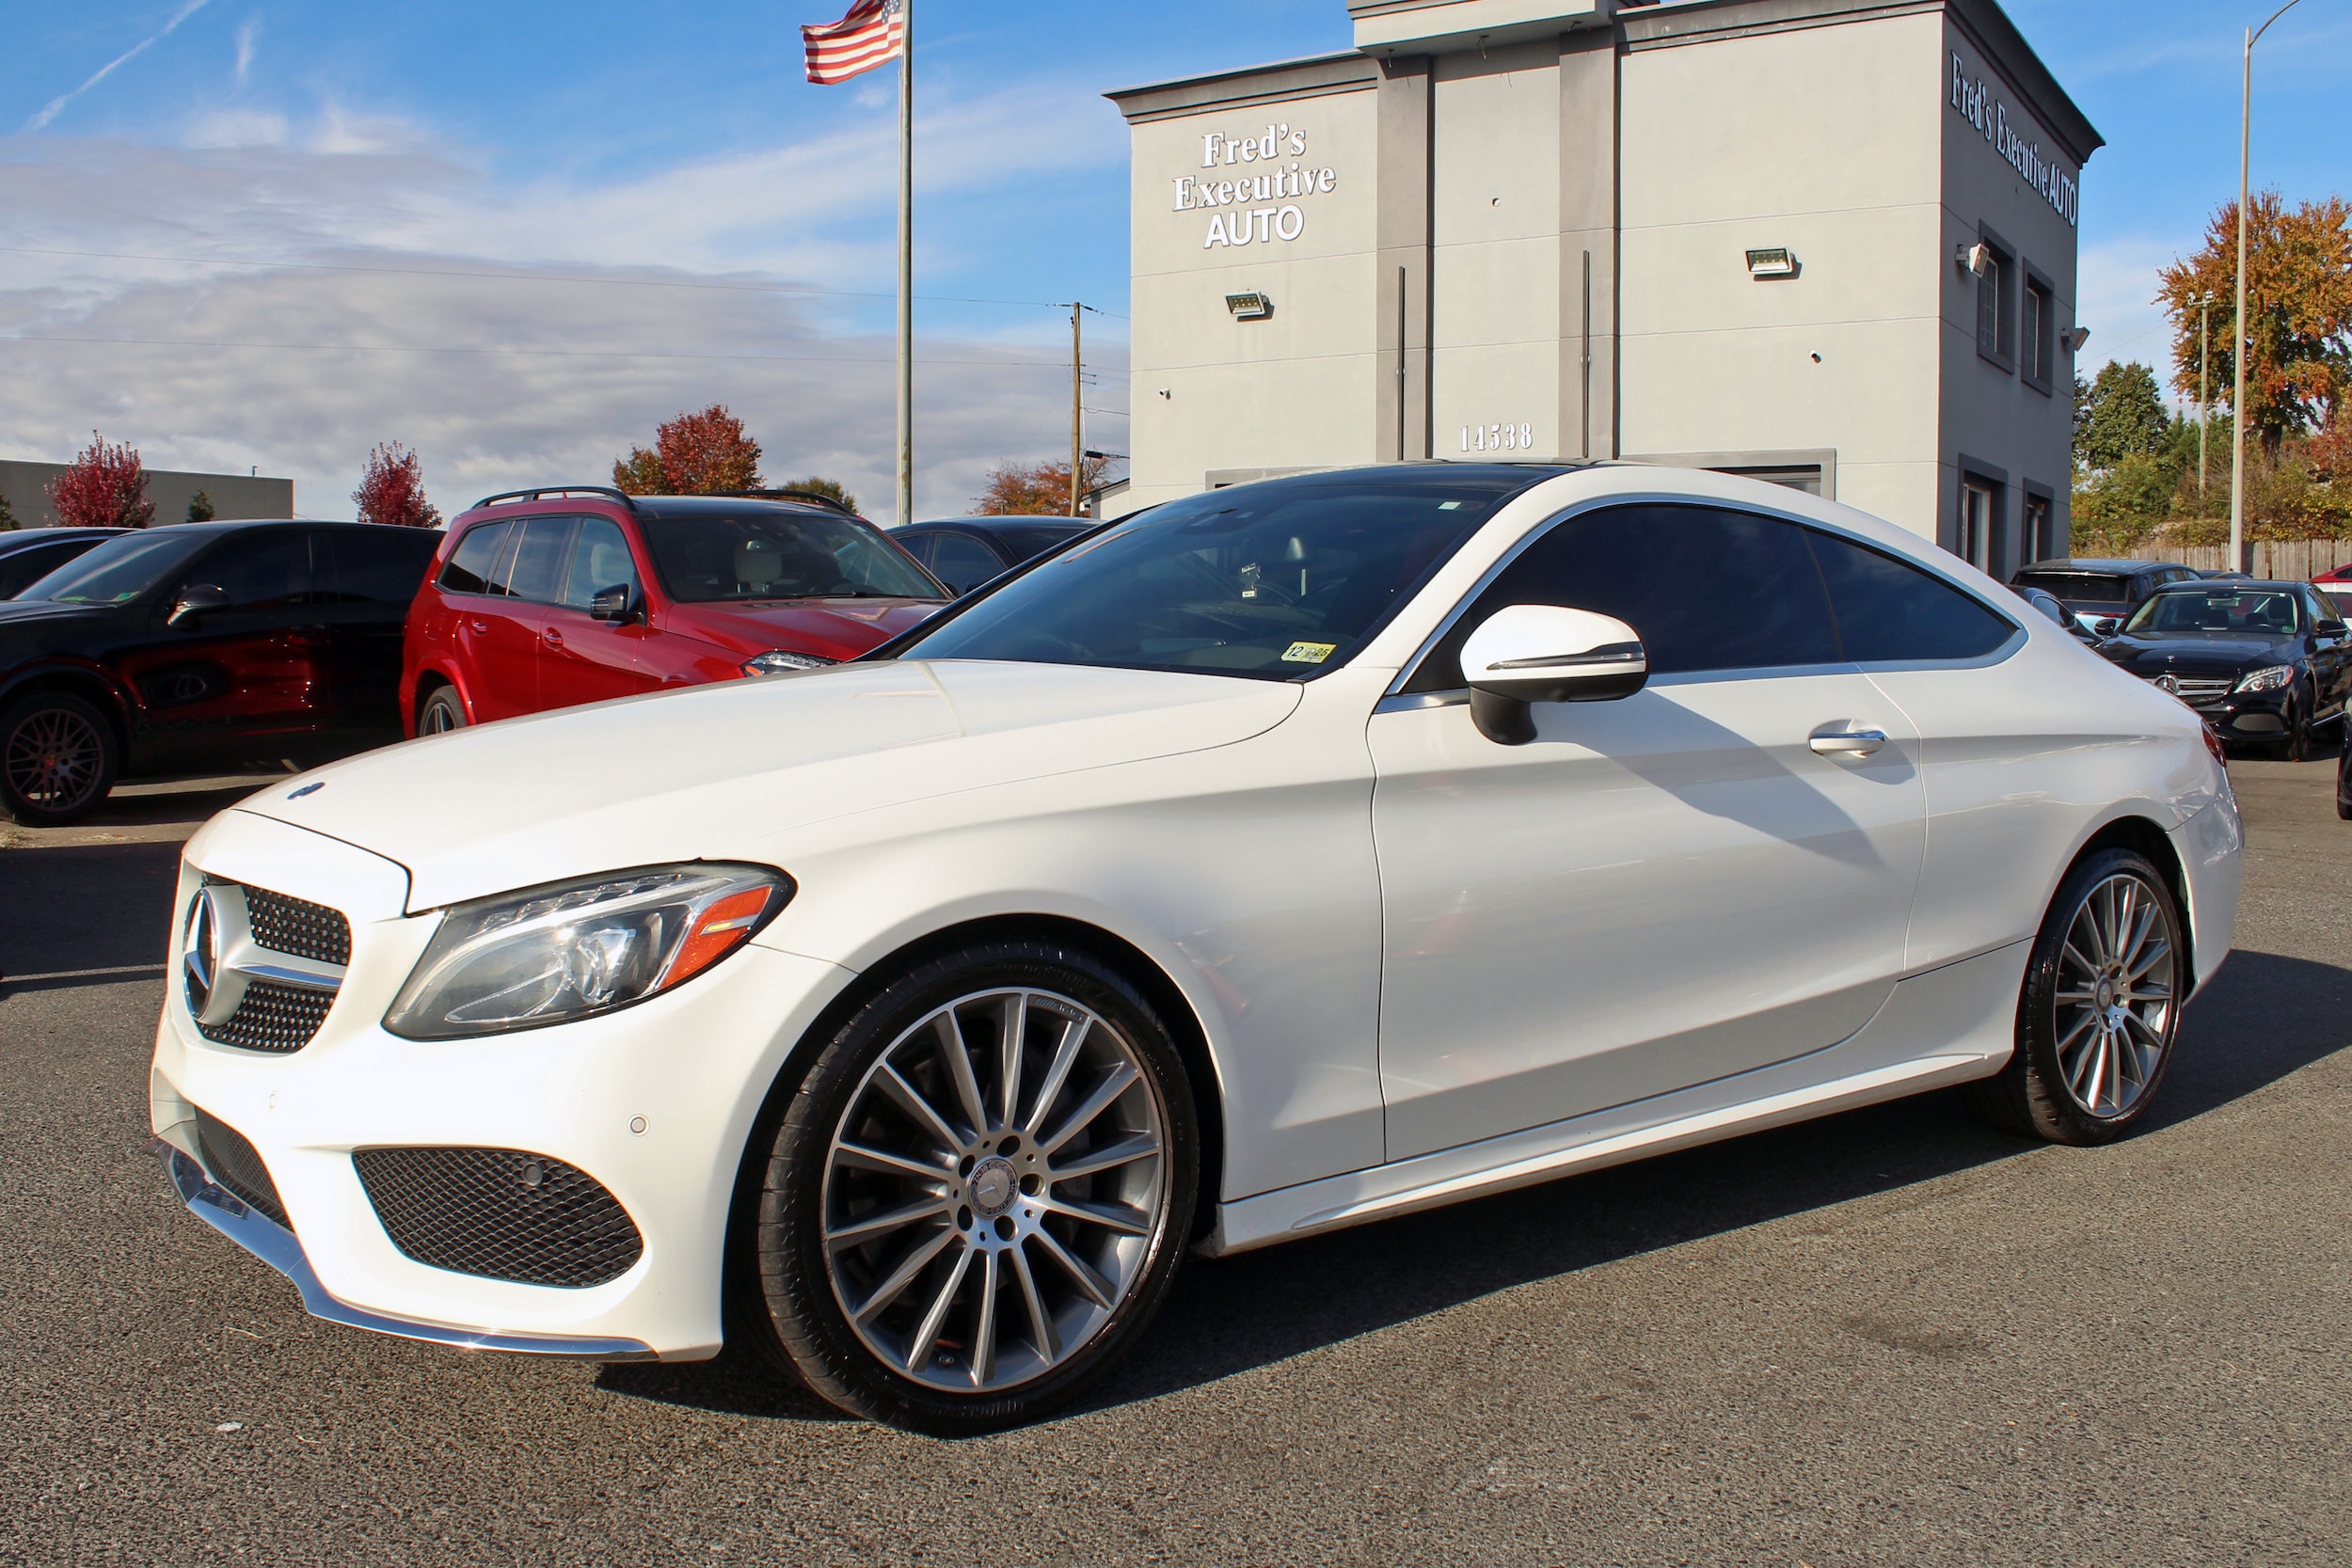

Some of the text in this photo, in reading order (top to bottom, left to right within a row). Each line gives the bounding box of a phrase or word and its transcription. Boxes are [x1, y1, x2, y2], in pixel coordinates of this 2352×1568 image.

[1200, 122, 1307, 168] Fred's
[1950, 50, 2076, 227] Fred's Executive AUTO
[1172, 162, 1337, 212] Executive
[1203, 204, 1305, 249] AUTO
[1460, 422, 1534, 452] 14538
[1287, 645, 1304, 657] 12
